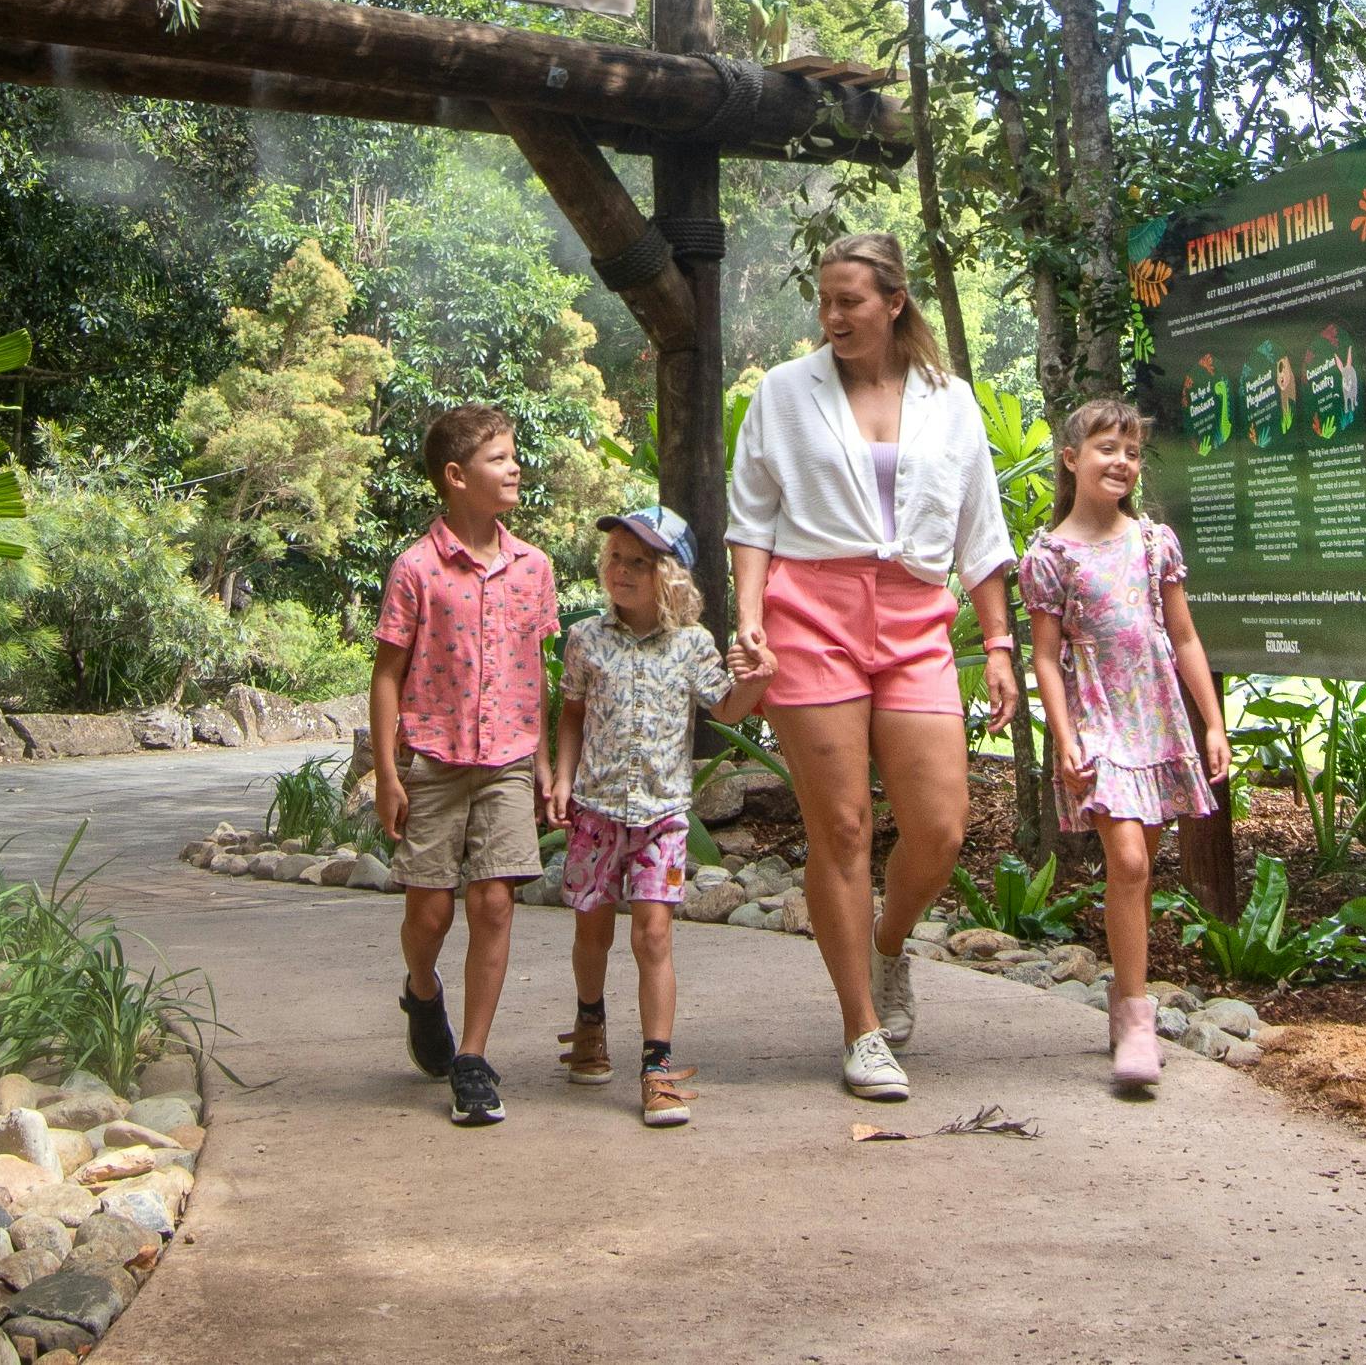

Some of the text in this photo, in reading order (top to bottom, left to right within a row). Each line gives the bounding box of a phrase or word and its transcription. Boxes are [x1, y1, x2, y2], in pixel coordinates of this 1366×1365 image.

[1187, 194, 1334, 275] EXTINCTION TRAIL
[1206, 289, 1216, 299] GET
[1217, 284, 1232, 296] READY
[1234, 280, 1244, 291] FOR
[1245, 279, 1249, 288] A
[1282, 258, 1316, 277] ADVENTURE!
[1312, 376, 1334, 394] Country
[1201, 592, 1210, 601] still
[1211, 592, 1221, 601] time
[1246, 591, 1273, 603] endangered
[1273, 591, 1291, 603] species
[1292, 591, 1301, 601] and
[1302, 591, 1310, 601] the
[1311, 591, 1332, 601] beautiful
[1333, 591, 1349, 604] planet
[1349, 591, 1361, 601] that
